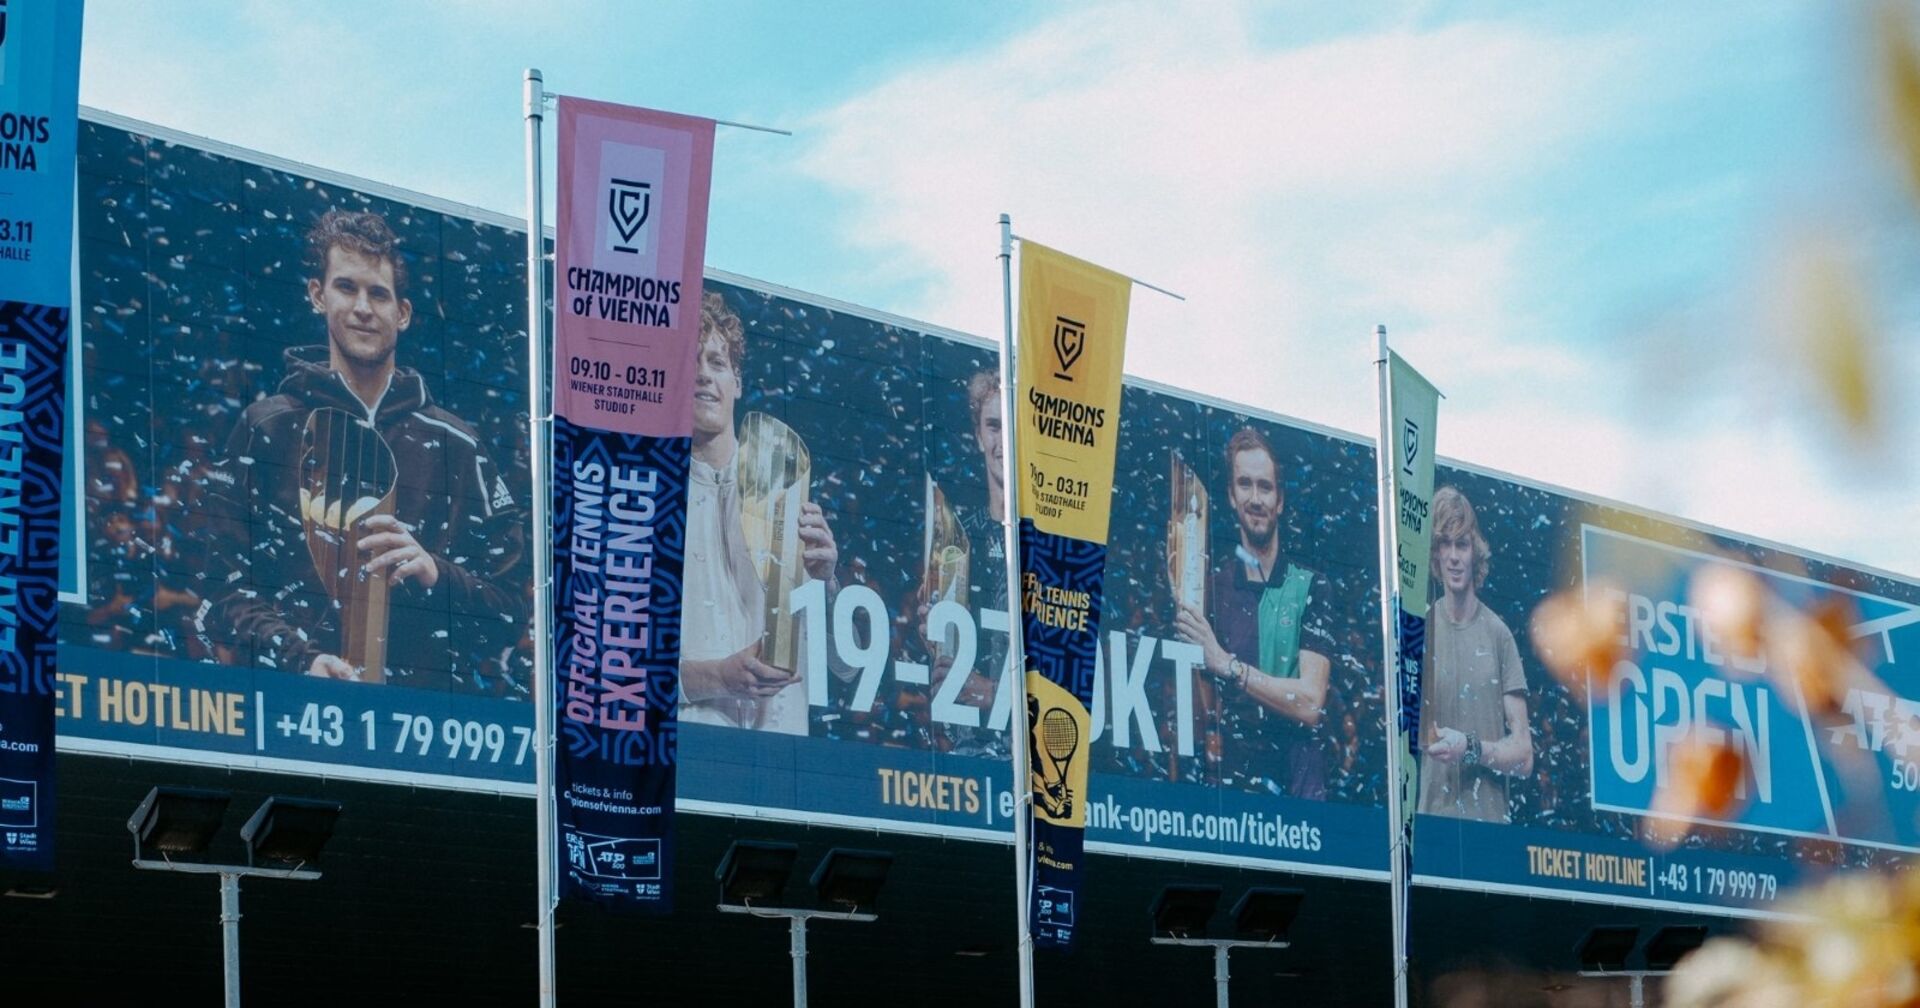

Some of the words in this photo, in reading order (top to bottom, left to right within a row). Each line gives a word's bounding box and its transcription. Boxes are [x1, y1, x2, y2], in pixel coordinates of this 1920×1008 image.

[567, 266, 682, 304] CHAMPIONS
[573, 296, 595, 317] of
[597, 297, 672, 328] VIENNA
[570, 356, 611, 381] 09.10
[626, 366, 666, 389] 03.11
[570, 379, 605, 396] WIENER
[606, 384, 664, 404] STADTHALLE
[594, 398, 628, 414] STUDIO
[630, 403, 636, 415] F
[1040, 492, 1086, 511] STADTHALLE
[1056, 476, 1089, 498] 03.11
[571, 460, 606, 574] TENNIS
[600, 466, 658, 731] EXPERIENCE
[1046, 585, 1091, 610] TENNIS
[566, 587, 599, 725] OFFICIAL
[100, 678, 246, 737] HOTLINE
[276, 702, 344, 747] +43
[360, 709, 376, 750] 1
[392, 712, 433, 756] 79
[442, 718, 505, 763] 999
[1607, 660, 1772, 803] OPEN
[878, 768, 980, 813] TICKETS
[1891, 759, 1920, 792] 50
[613, 789, 633, 801] info
[1526, 845, 1581, 878] TICKET
[1585, 853, 1646, 887] HOTLINE
[1658, 863, 1688, 892] +43
[1693, 866, 1701, 893] 1
[1707, 867, 1725, 896] 79
[1729, 871, 1756, 899] 999
[1759, 873, 1777, 901] 79
